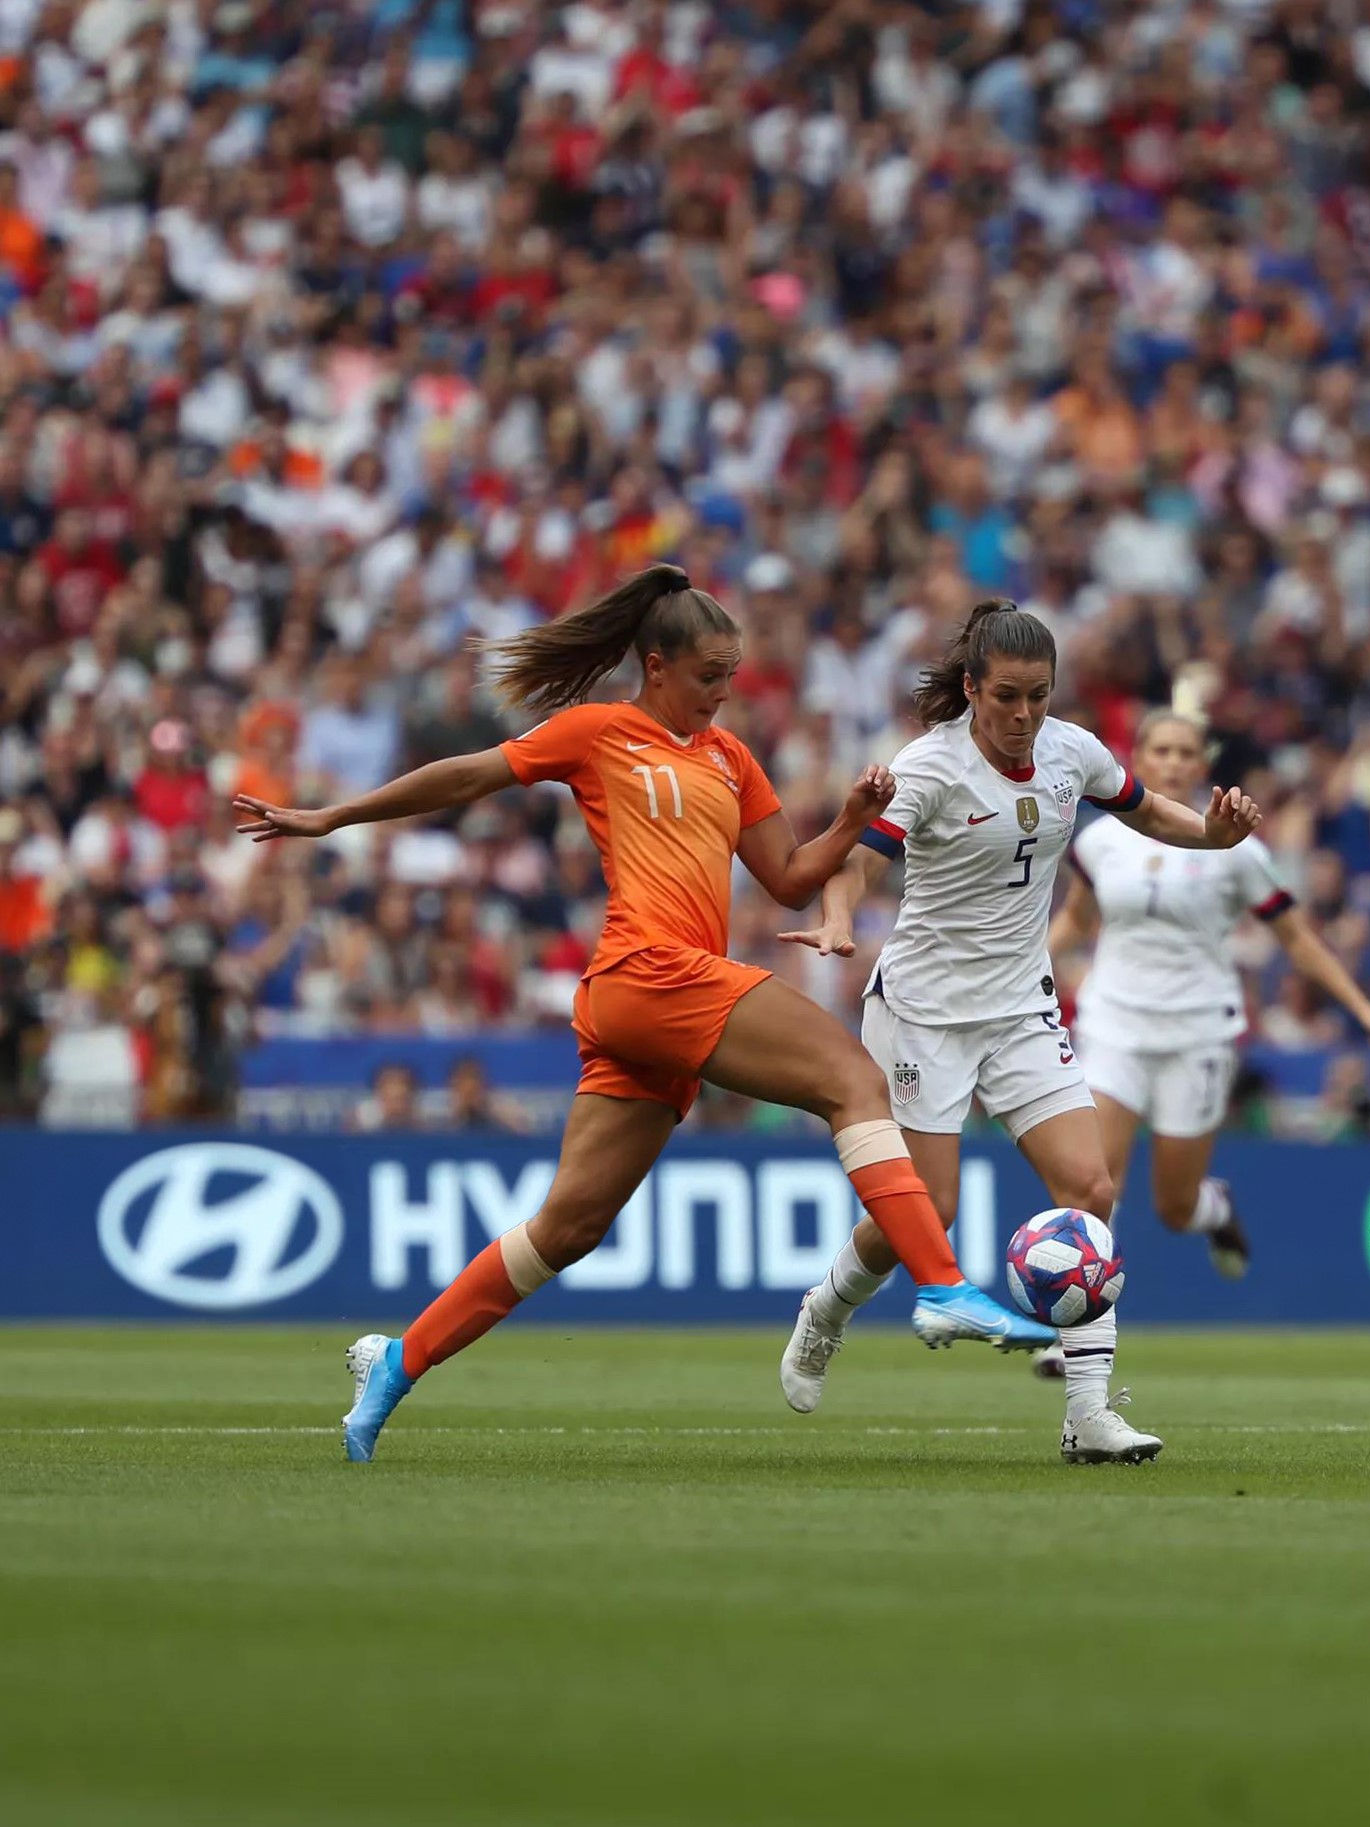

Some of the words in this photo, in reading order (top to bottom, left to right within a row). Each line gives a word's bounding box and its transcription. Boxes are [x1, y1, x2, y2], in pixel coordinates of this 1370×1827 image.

[631, 765, 683, 818] 11
[1057, 788, 1074, 804] USA
[1007, 837, 1038, 888] 5
[896, 1072, 917, 1086] USA
[370, 1163, 995, 1291] HYUNDI
